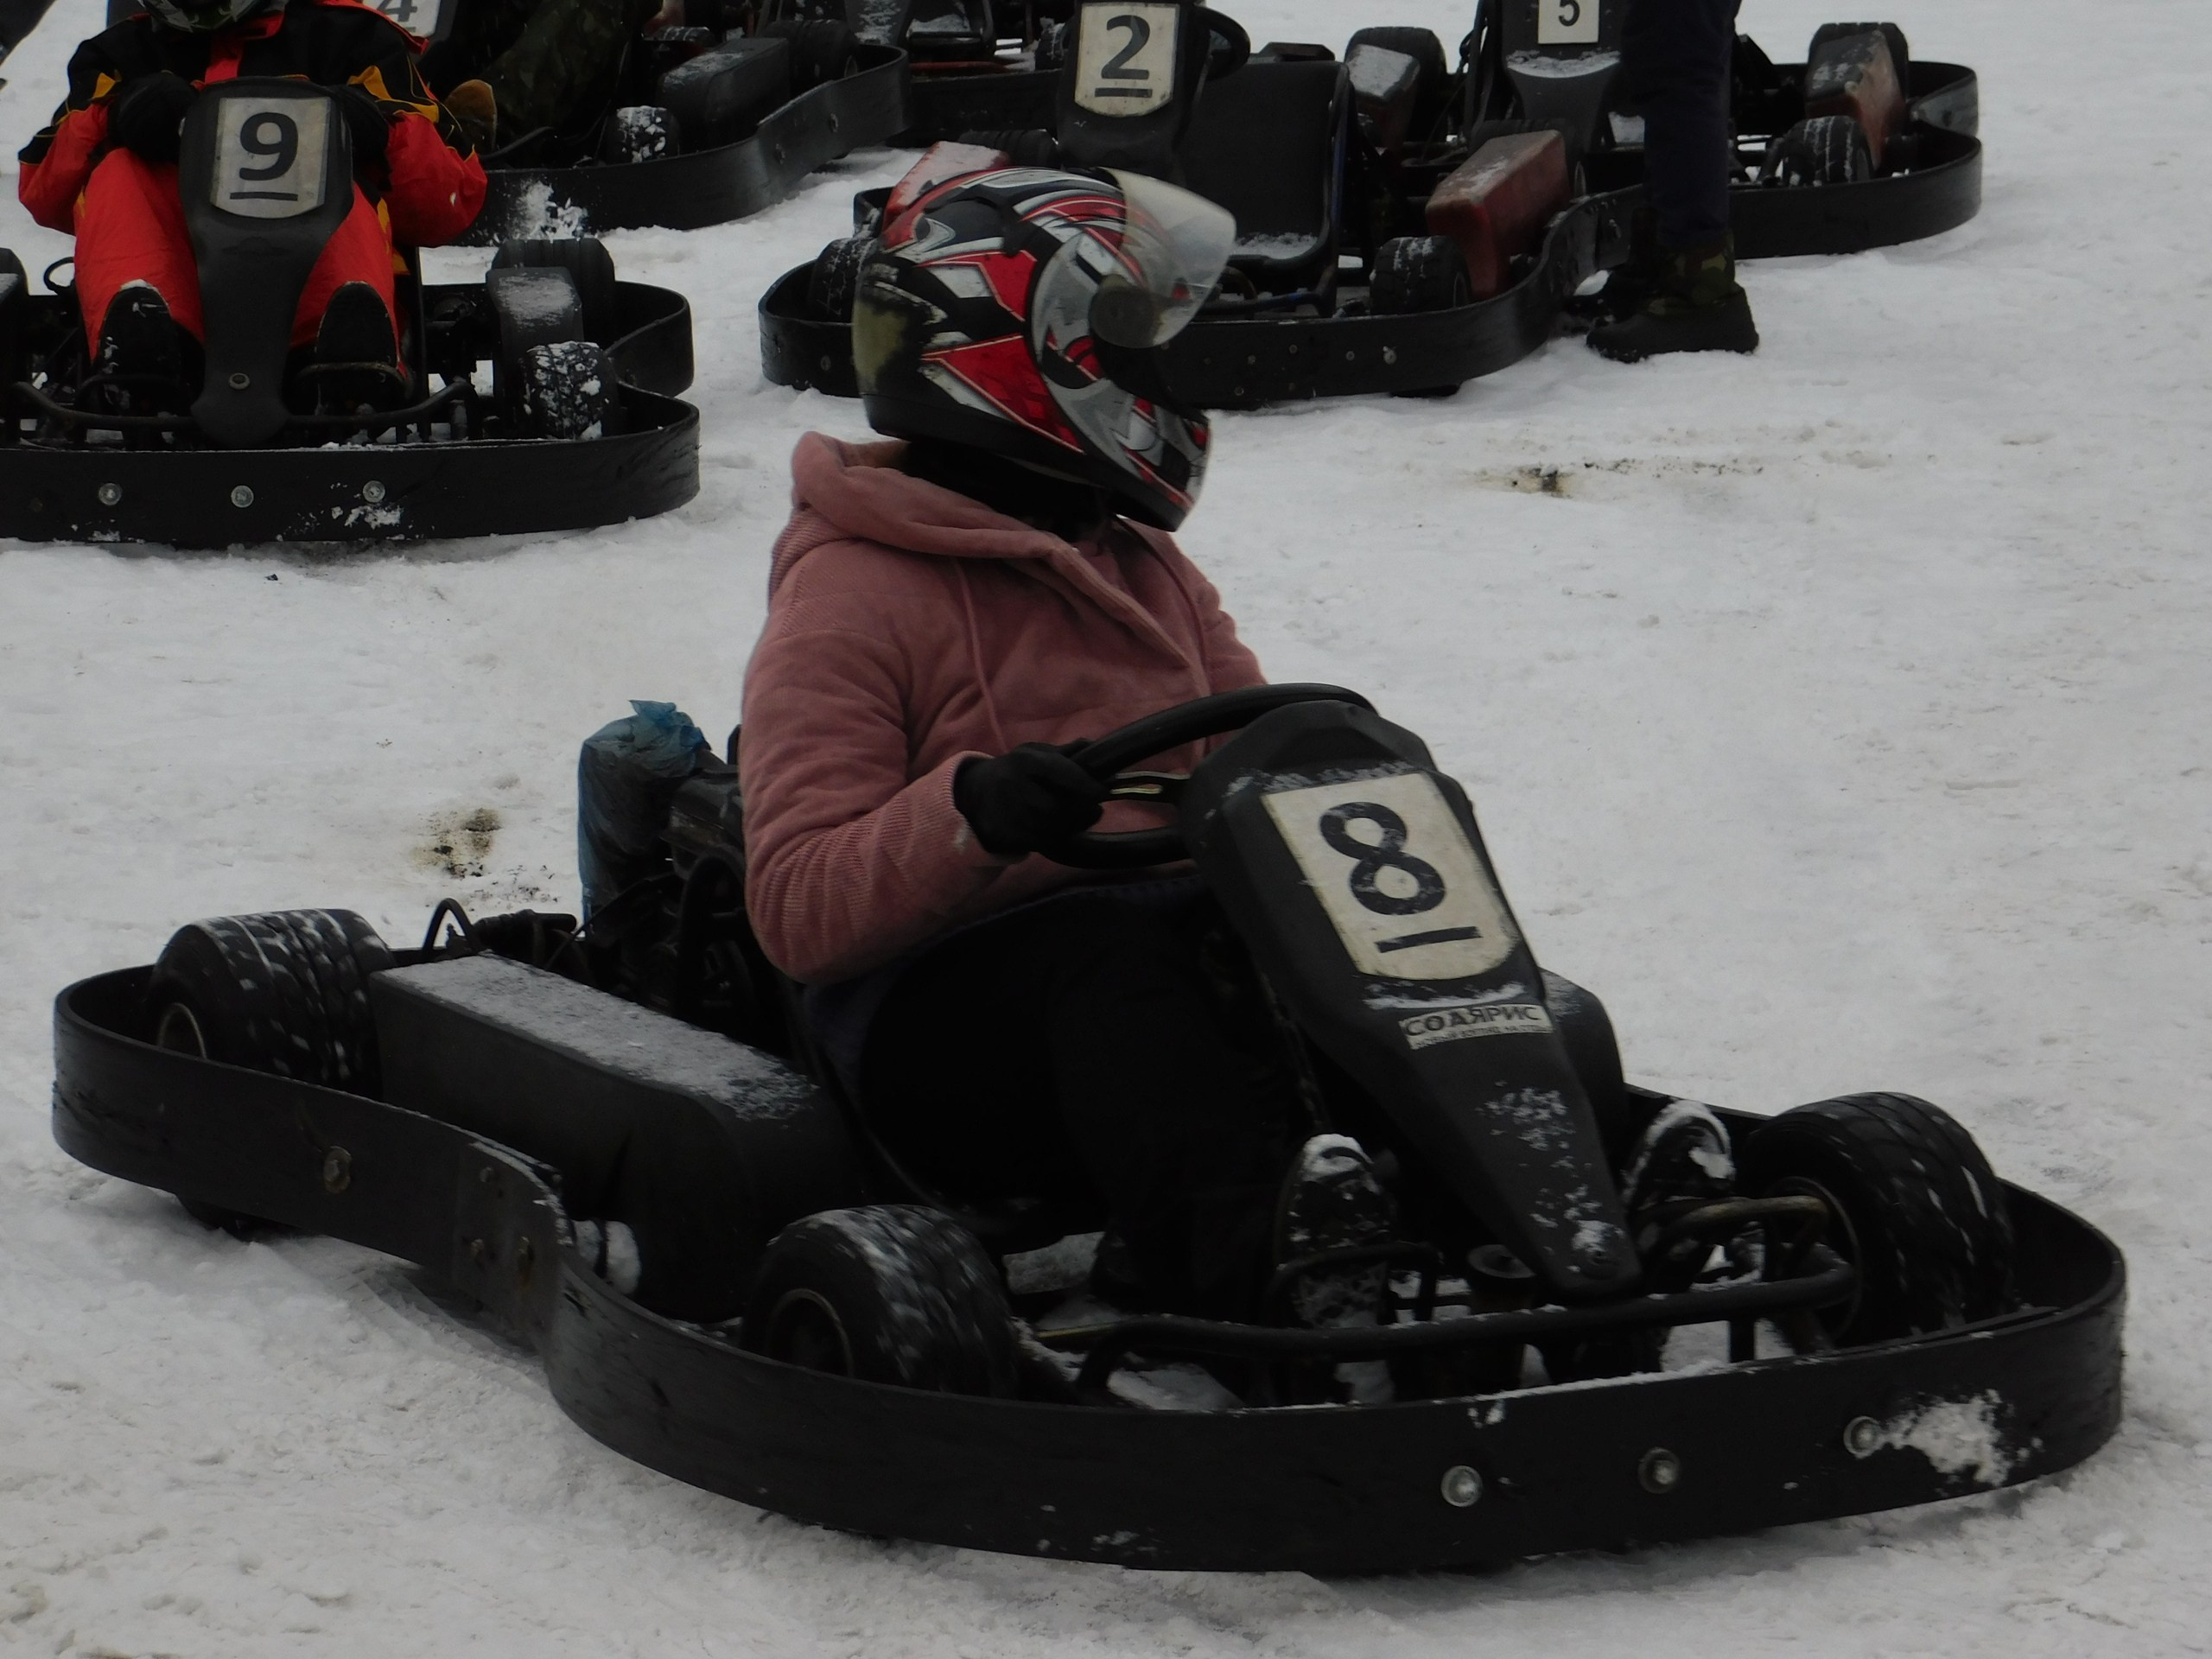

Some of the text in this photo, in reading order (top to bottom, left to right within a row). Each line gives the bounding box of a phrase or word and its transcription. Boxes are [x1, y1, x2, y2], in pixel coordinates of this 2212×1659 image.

[377, 0, 417, 22] 4
[1558, 0, 1580, 26] 5
[1101, 15, 1150, 79] 2
[239, 111, 298, 181] 9
[1319, 802, 1446, 915] 8
